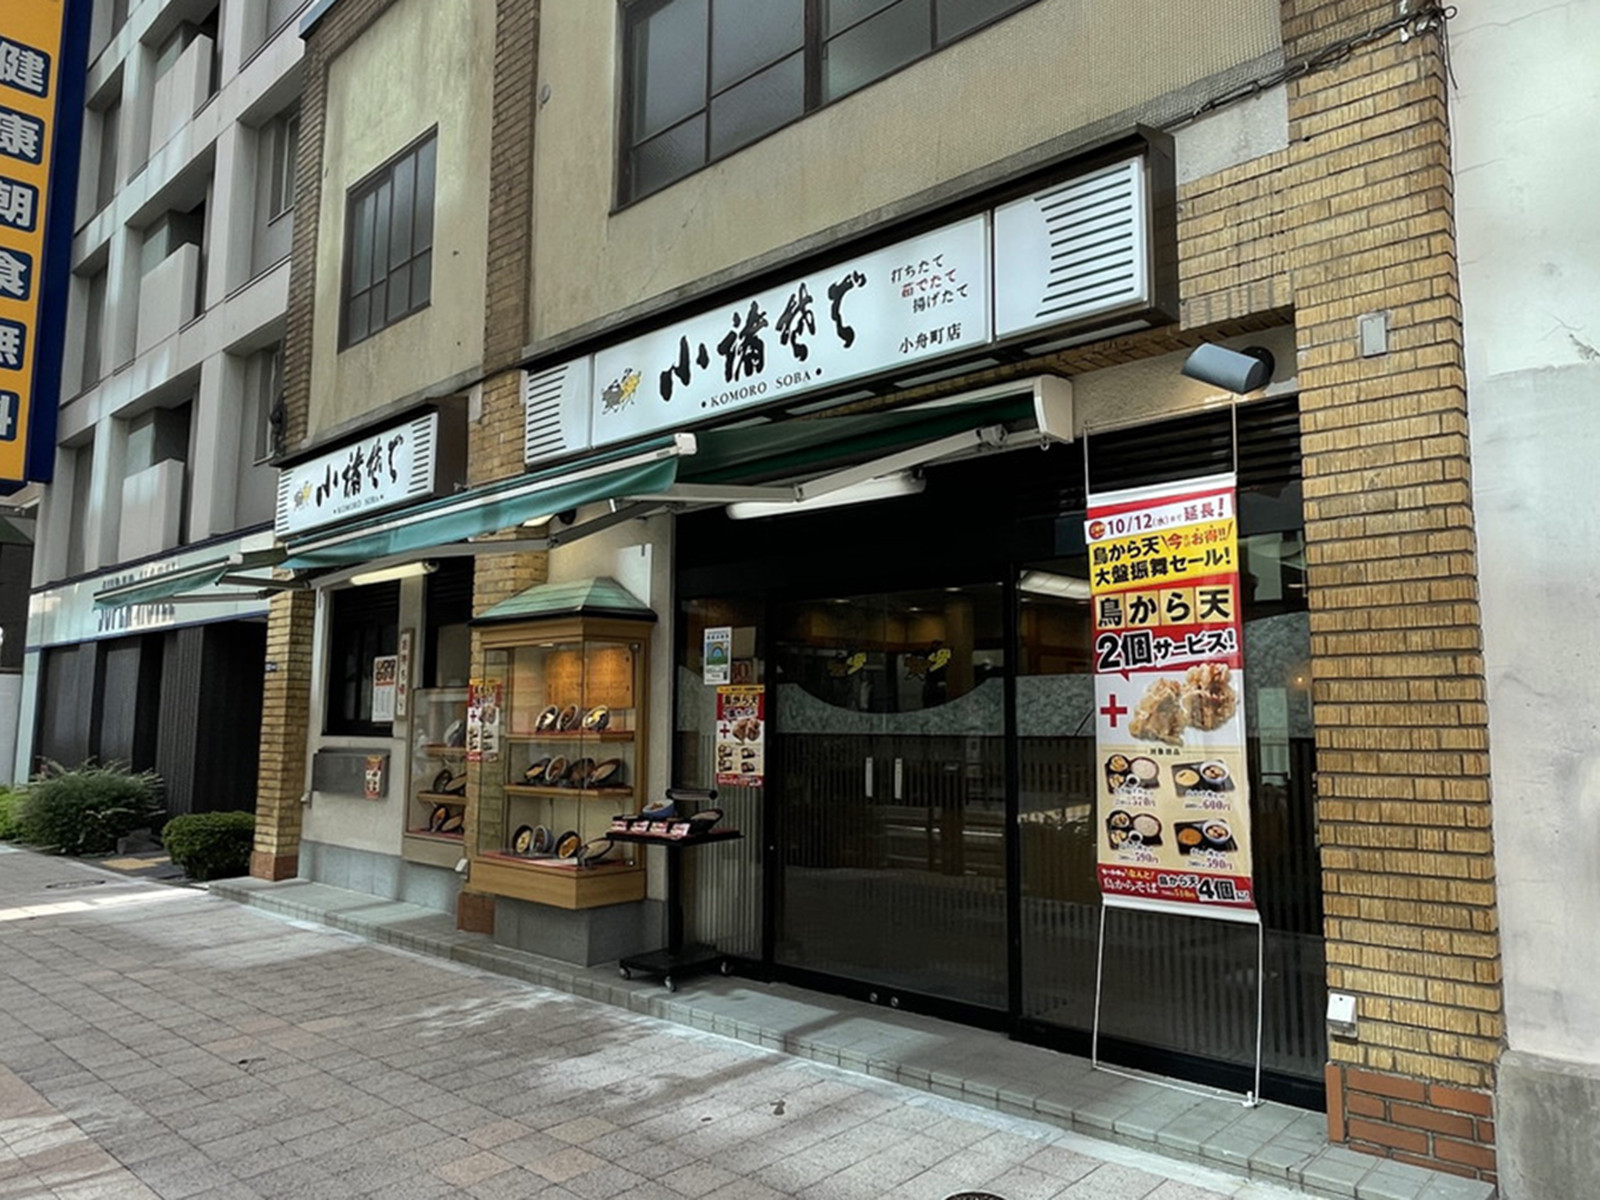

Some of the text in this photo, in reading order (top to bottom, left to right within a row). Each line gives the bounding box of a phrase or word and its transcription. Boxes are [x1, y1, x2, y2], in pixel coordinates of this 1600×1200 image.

[891, 253, 943, 283] 打ちたて
[913, 283, 968, 313] 揚げたて
[899, 322, 962, 354] 小舟町店
[710, 371, 812, 408] KOMORO SOBA
[1093, 535, 1160, 566] 鳥から天
[1098, 588, 1231, 627] 鳥から天
